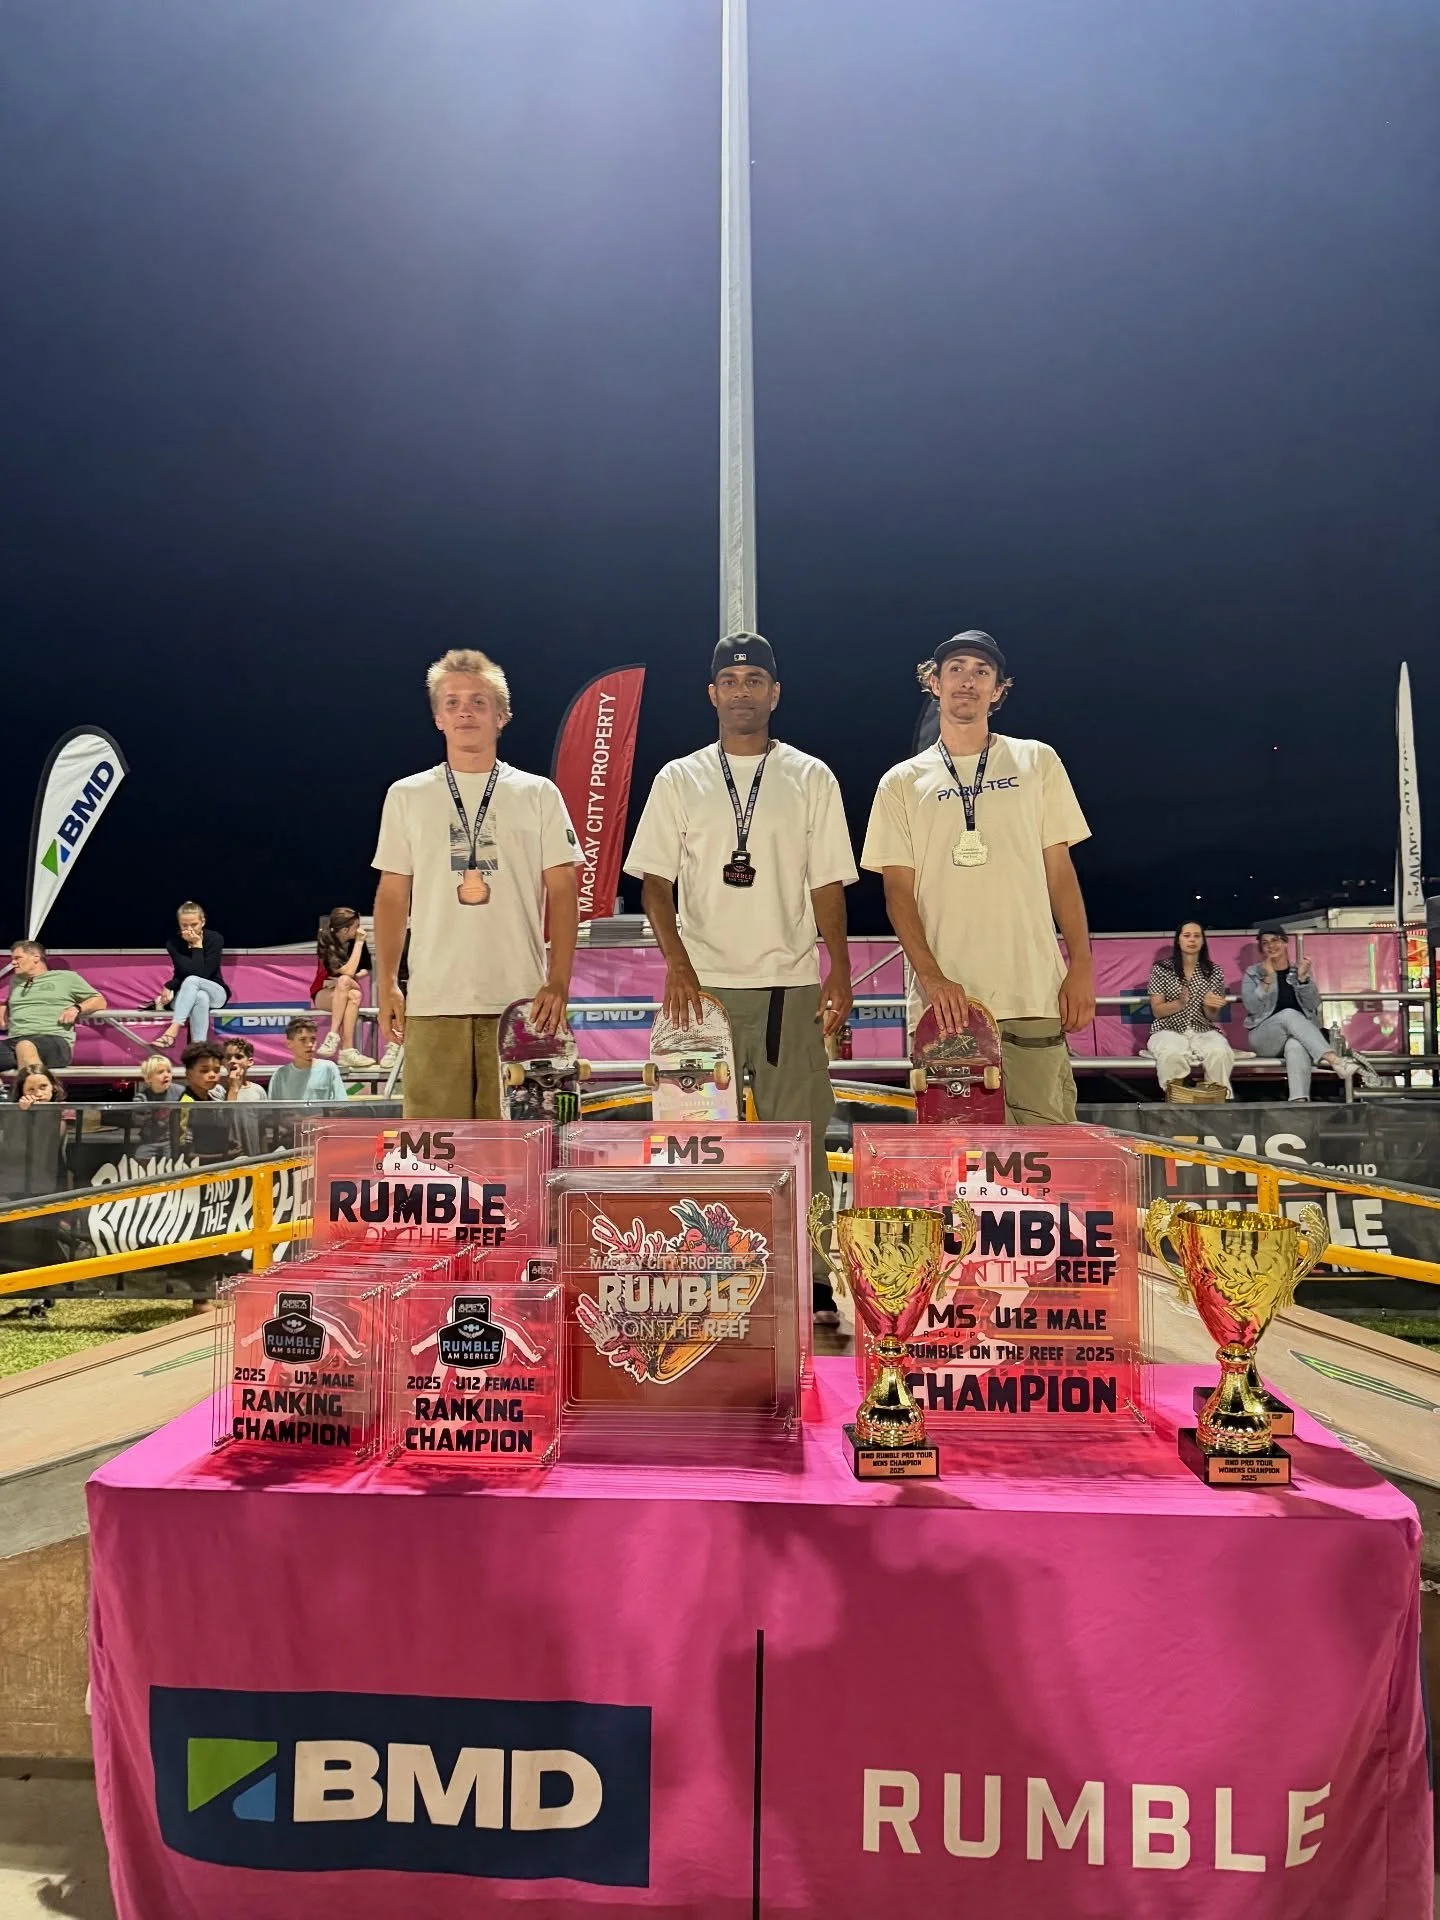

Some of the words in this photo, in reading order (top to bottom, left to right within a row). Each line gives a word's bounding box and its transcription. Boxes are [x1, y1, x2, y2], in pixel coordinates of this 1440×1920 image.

[590, 692, 617, 787] PROPERTY
[57, 761, 115, 847] BMD
[586, 790, 605, 833] CITY
[577, 836, 601, 913] MACKAY
[376, 1131, 456, 1160] FMS
[643, 1135, 725, 1165] FMS
[376, 1162, 454, 1172] GROUP
[958, 1151, 1052, 1184] FMS
[205, 1178, 234, 1203] AND
[329, 1176, 507, 1225] RUMBLE
[959, 1187, 1051, 1196] GROUP
[201, 1201, 228, 1234] THE
[941, 1203, 1115, 1258] UMBLE
[455, 1227, 507, 1247] REEF
[590, 1254, 645, 1271] MACKAY
[649, 1254, 679, 1271] CITY
[681, 1254, 750, 1271] PROPERTY
[1055, 1260, 1117, 1285] REEF
[598, 1274, 752, 1315] RUMBLE
[622, 1319, 656, 1338] ON
[662, 1319, 701, 1338] THE
[704, 1319, 750, 1339] REEF
[927, 1304, 977, 1329] MS
[995, 1306, 1038, 1330] U12
[1047, 1308, 1107, 1331] MALE
[267, 1334, 321, 1348] RUMBLE
[442, 1340, 500, 1352] RUMBLE
[911, 1331, 976, 1339] ROUP
[906, 1343, 964, 1360] RUMBLE
[970, 1345, 991, 1360] ON
[996, 1346, 1024, 1360] THE
[1030, 1346, 1064, 1361] REEF
[1076, 1346, 1115, 1361] 2025
[234, 1367, 266, 1382] 2025
[294, 1370, 318, 1385] U12
[321, 1373, 355, 1387] MALE
[407, 1376, 441, 1390] 2025
[455, 1376, 480, 1390] U12
[485, 1377, 535, 1391] FEMALE
[241, 1388, 343, 1417] RANKING
[905, 1373, 1117, 1413] CHAMPION
[415, 1398, 524, 1424] RANKING
[232, 1417, 351, 1447] CHAMPION
[405, 1427, 533, 1453] CHAMPION
[293, 1739, 603, 1831] BMD
[862, 1768, 1332, 1873] RUMBLE
